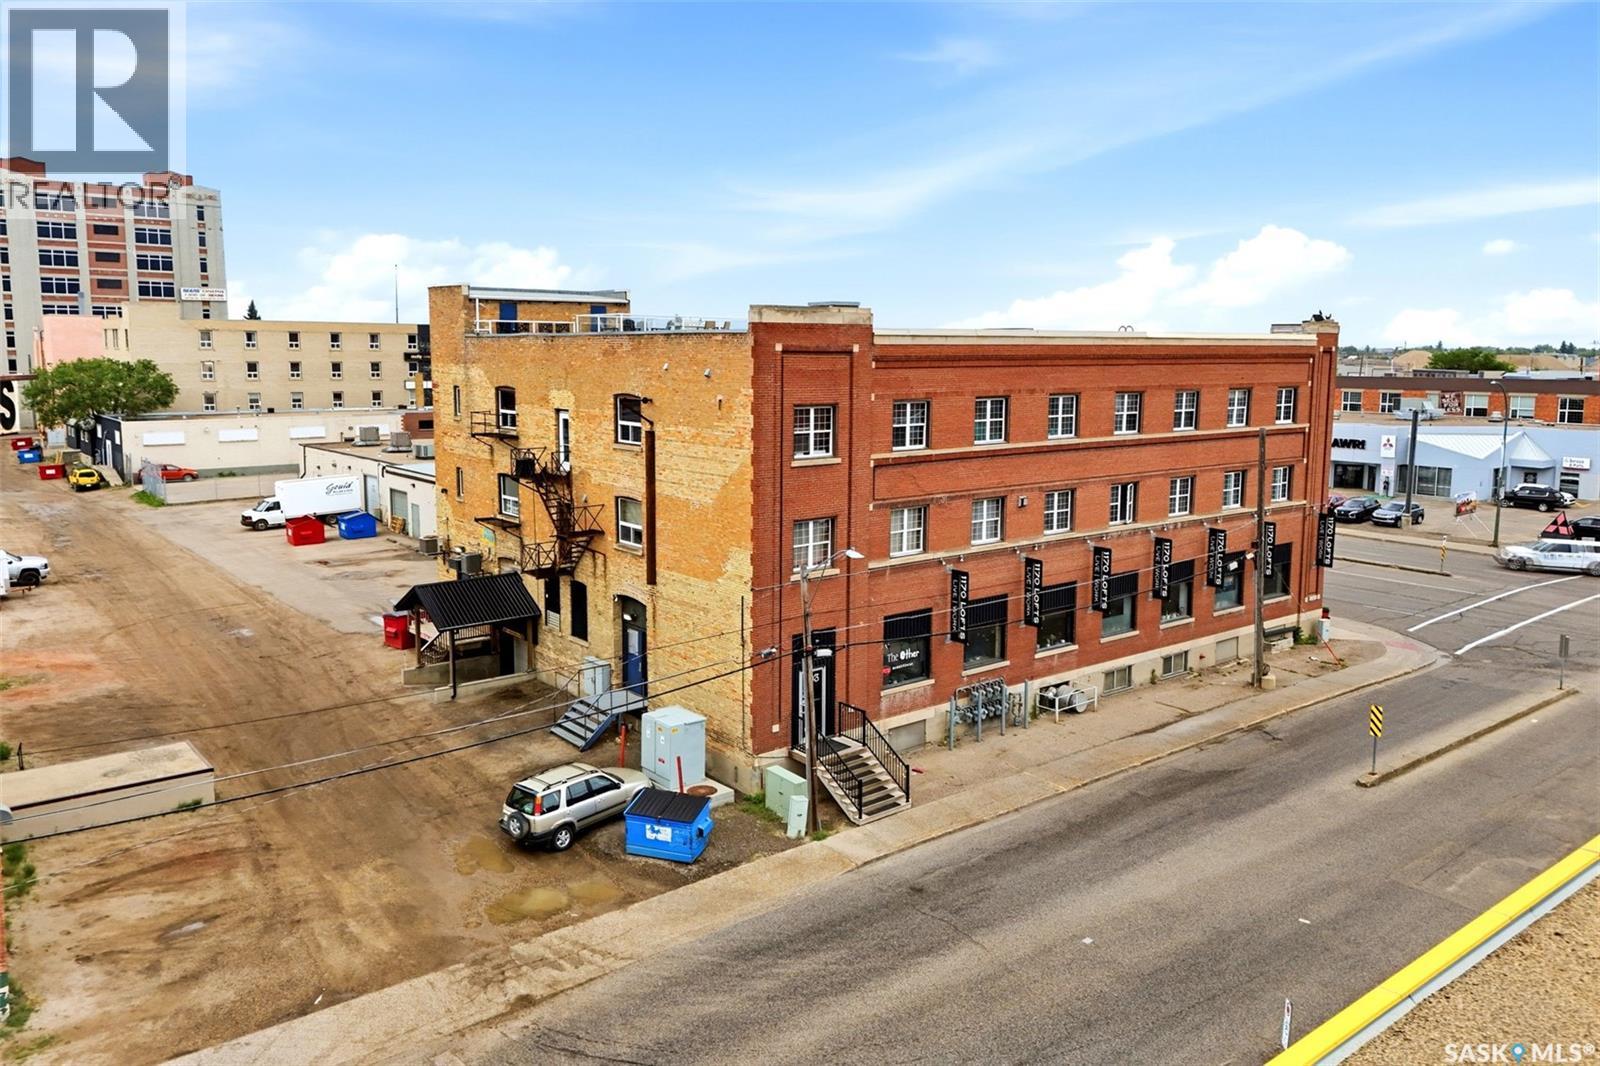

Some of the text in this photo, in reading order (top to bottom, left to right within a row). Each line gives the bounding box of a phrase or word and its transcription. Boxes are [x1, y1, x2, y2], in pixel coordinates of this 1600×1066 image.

[1325, 536, 1333, 565] LOFTS
[1101, 575, 1109, 609] LOFTS
[887, 648, 920, 663] The Other
